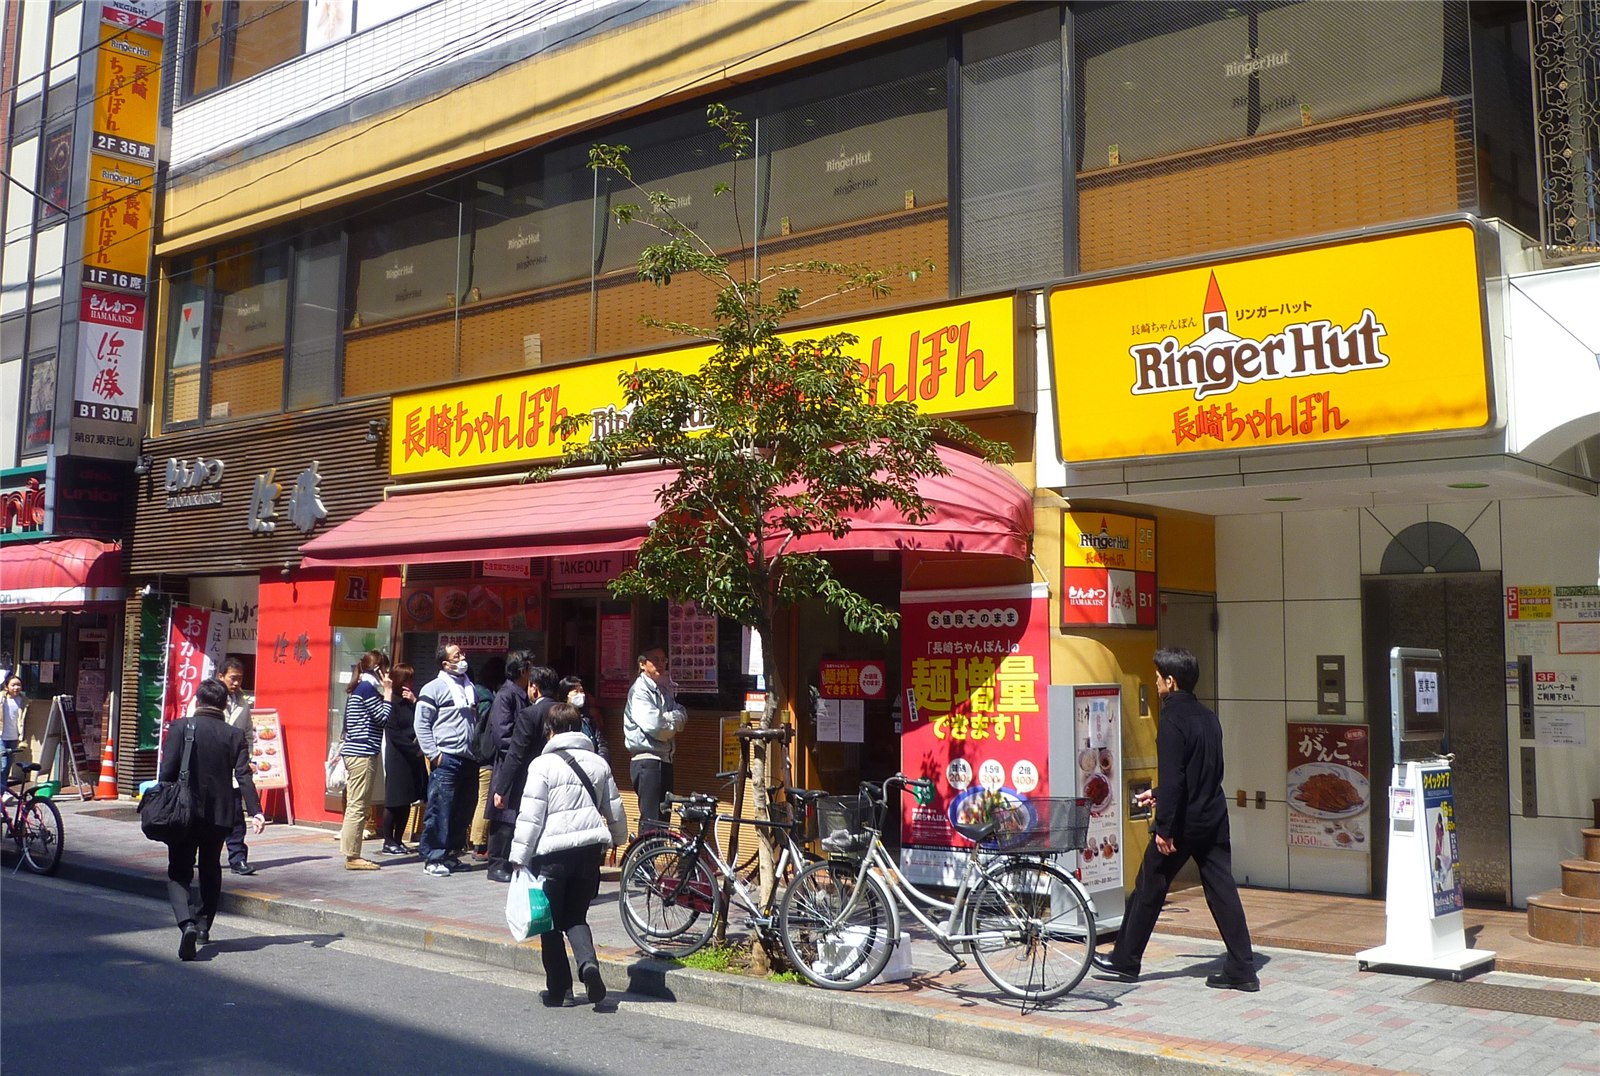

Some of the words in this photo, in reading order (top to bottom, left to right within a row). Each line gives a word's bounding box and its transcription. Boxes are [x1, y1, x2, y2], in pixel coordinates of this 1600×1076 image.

[114, 1, 148, 16] NEGISHI
[98, 136, 116, 150] 2F
[120, 140, 150, 158] 35席
[90, 270, 107, 282] 1F
[112, 273, 142, 290] 16席
[90, 294, 136, 314] とんかつ
[1236, 300, 1312, 321] リンガーハット
[91, 312, 134, 324] HAMAKATSU
[1131, 318, 1198, 336] 長崎ちゃんぽん
[1133, 336, 1286, 396] Ringer
[1288, 312, 1385, 374] Hut
[80, 404, 96, 418] B1
[102, 408, 134, 422] 30席
[1171, 390, 1350, 446] 長崎ちゃんぽん
[402, 384, 576, 463] 長崎ちゃんぽん
[1080, 533, 1116, 550] Ringer
[560, 559, 611, 575] TAKEOUT
[1068, 586, 1106, 598] とんかつ
[1140, 593, 1152, 608] B1
[930, 611, 1016, 626] お値段そのまま
[912, 656, 1040, 713] 麺増量
[1538, 673, 1554, 682] 3F
[1537, 683, 1576, 691] エレベーターを
